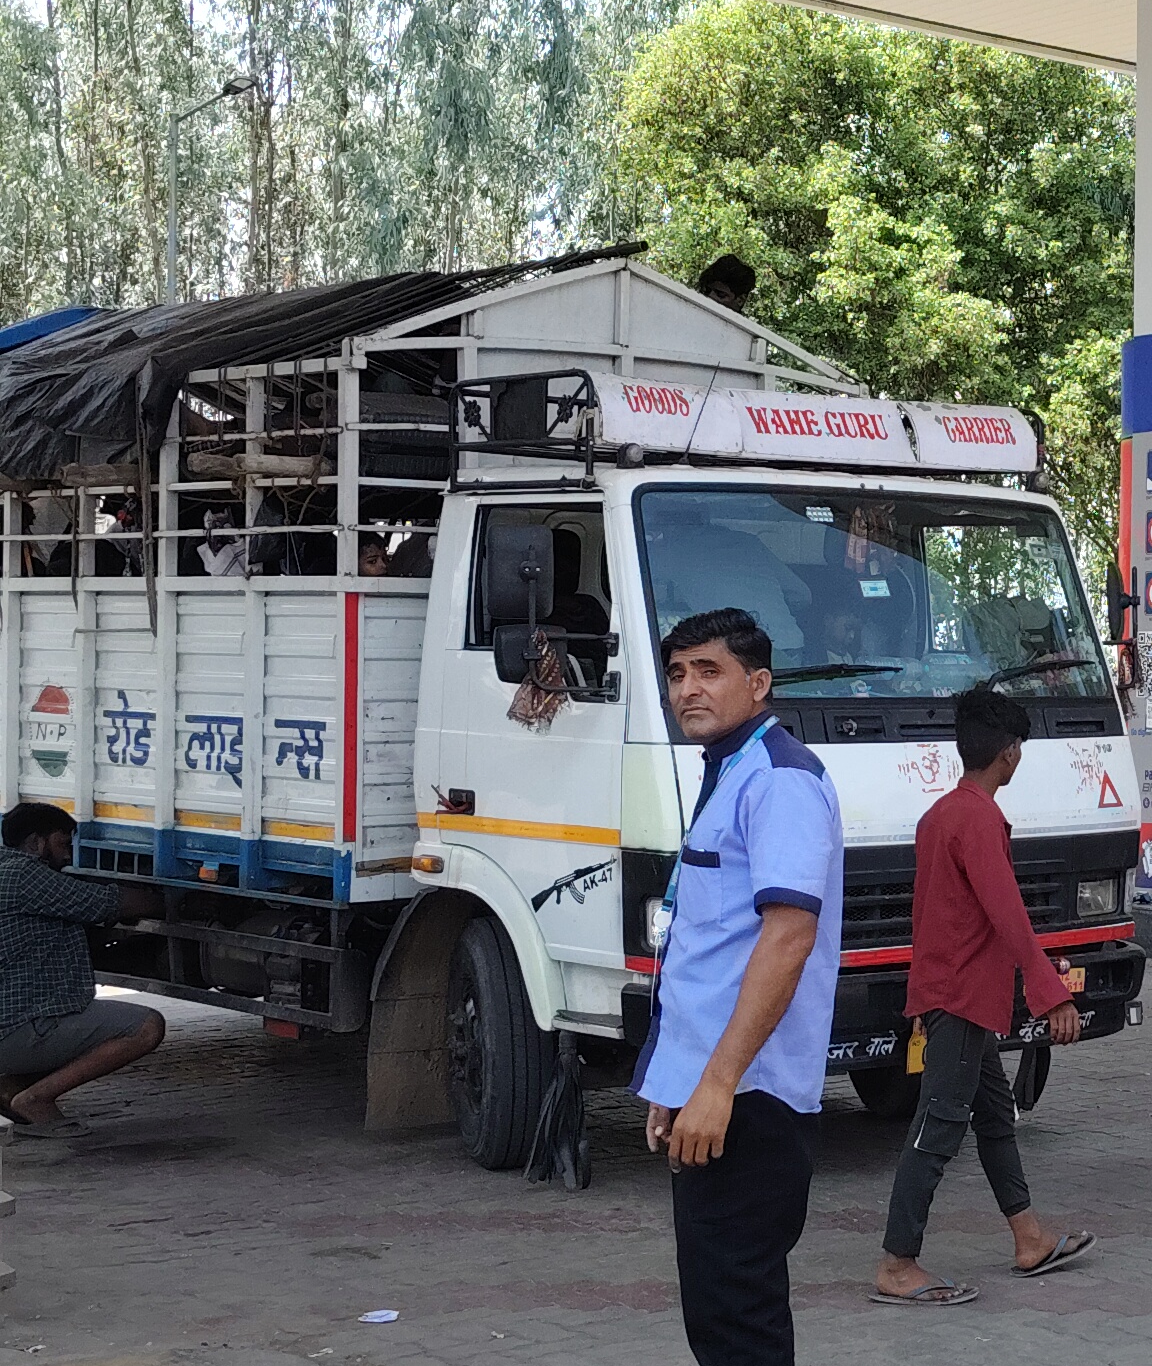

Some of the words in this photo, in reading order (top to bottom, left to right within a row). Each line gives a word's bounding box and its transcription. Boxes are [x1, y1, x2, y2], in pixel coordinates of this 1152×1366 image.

[622, 384, 690, 417] GOODS
[745, 406, 823, 437] WAHE
[824, 412, 889, 441] GURU
[941, 415, 1017, 446] CARRIER
[102, 689, 157, 766] रोड
[582, 866, 613, 893] AK-47
